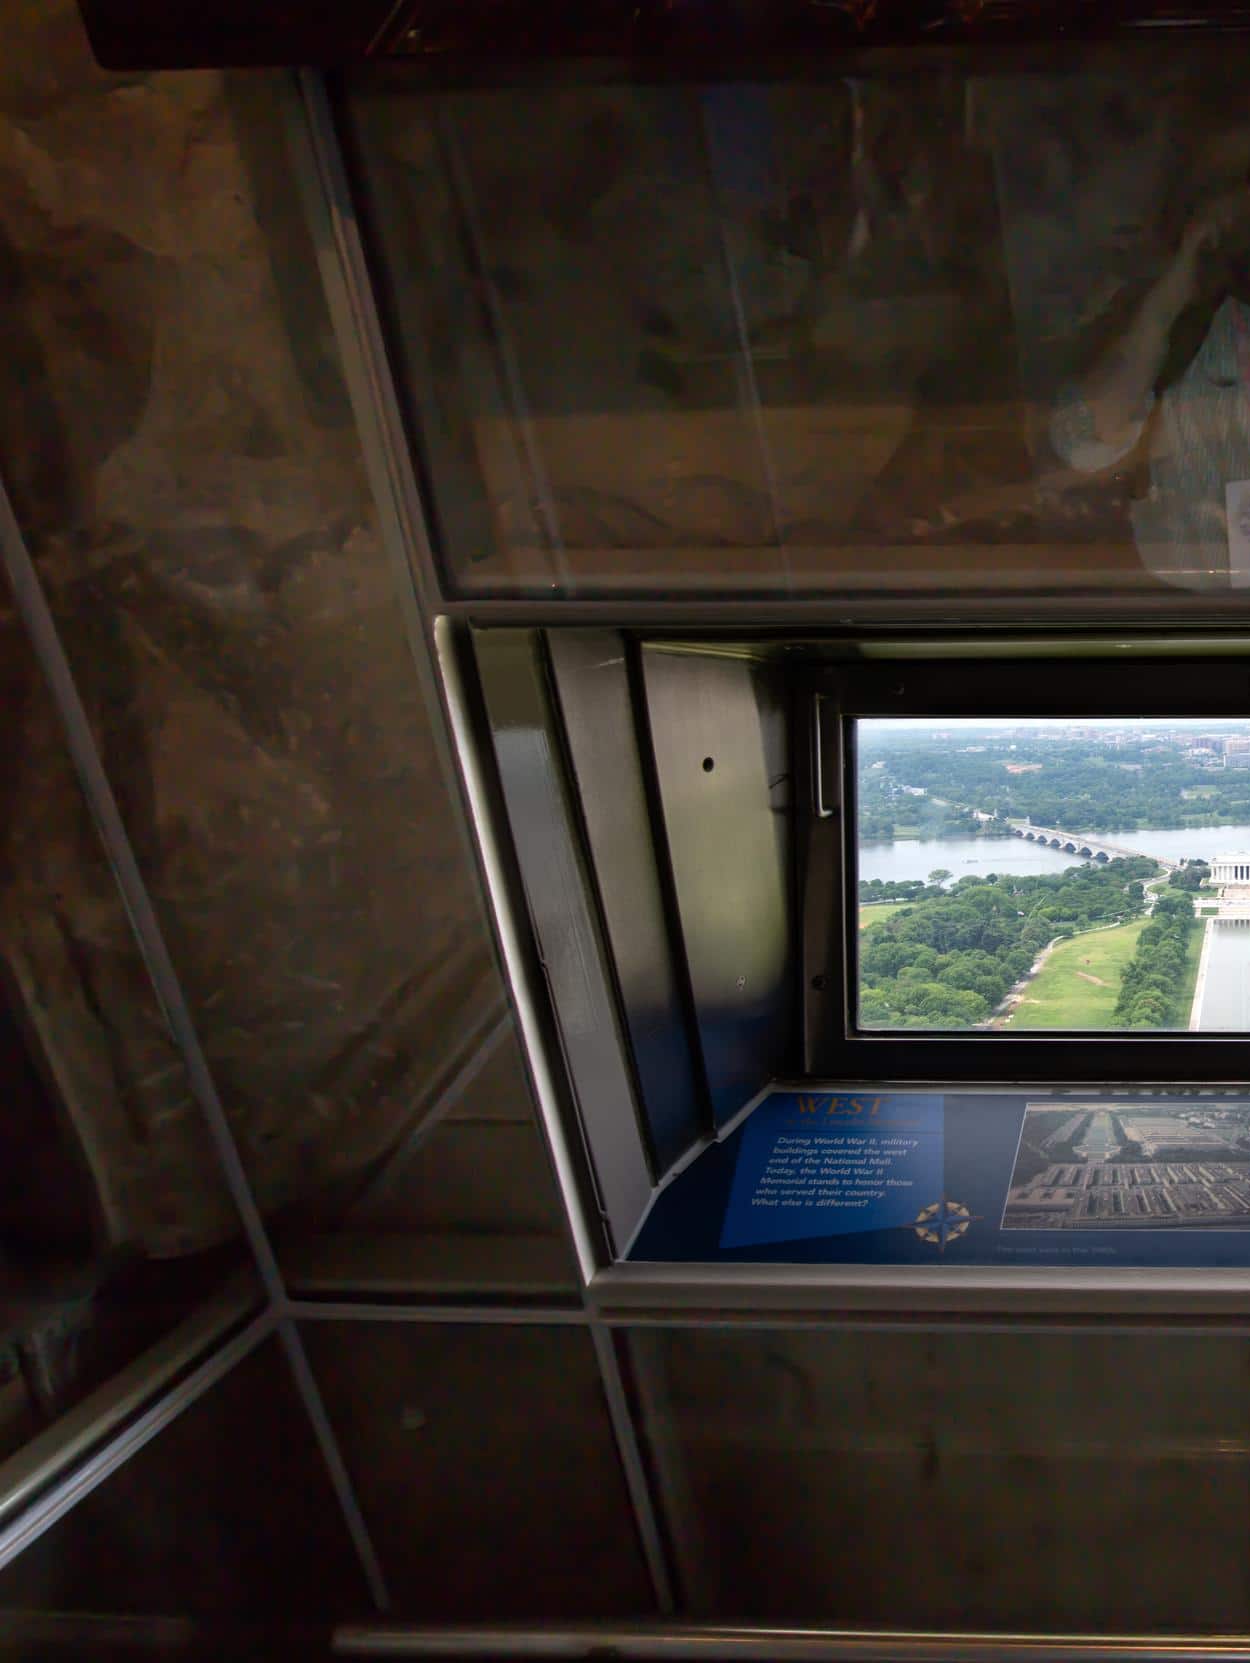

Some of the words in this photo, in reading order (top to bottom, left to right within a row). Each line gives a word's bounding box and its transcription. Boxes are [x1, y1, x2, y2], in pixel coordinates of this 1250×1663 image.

[797, 1095, 893, 1116] WEST
[777, 1136, 811, 1146] During
[814, 1136, 844, 1145] World
[847, 1137, 866, 1145] War
[880, 1137, 919, 1147] military
[773, 1147, 818, 1156] buildings
[821, 1147, 863, 1155] covered
[883, 1148, 907, 1156] west
[823, 1157, 867, 1165] National
[800, 1167, 816, 1175] the
[820, 1167, 851, 1175] World
[853, 1167, 873, 1175] War
[760, 1177, 806, 1186] Memorial
[808, 1177, 840, 1185] stands
[855, 1178, 884, 1186] honor
[755, 1188, 778, 1196] who
[780, 1188, 816, 1196] served
[818, 1188, 842, 1196] their
[751, 1198, 778, 1207] What
[781, 1198, 803, 1206] else
[805, 1198, 814, 1206] is
[815, 1198, 870, 1208] different?
